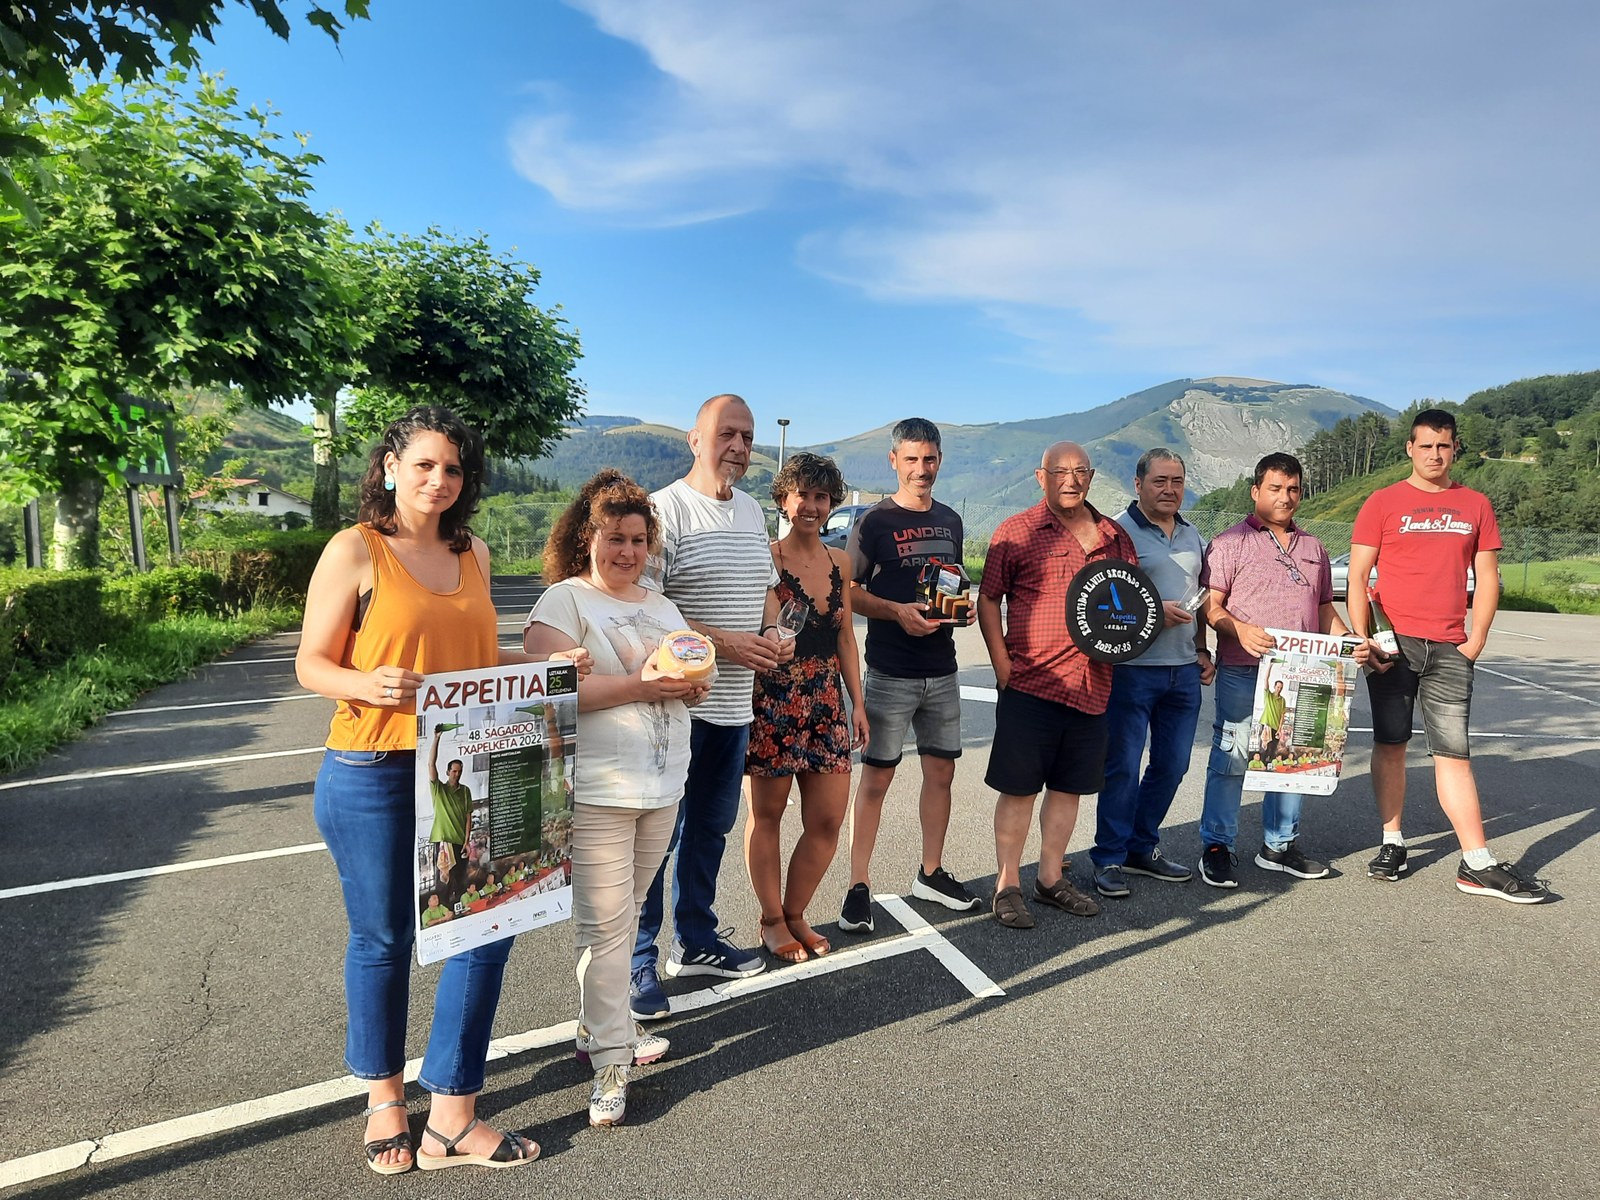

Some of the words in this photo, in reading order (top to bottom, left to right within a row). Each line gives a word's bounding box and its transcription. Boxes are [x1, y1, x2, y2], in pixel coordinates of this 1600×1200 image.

[893, 527, 953, 542] UNDER
[1110, 612, 1137, 621] Azpeitia
[1094, 639, 1132, 654] 2022-07-25
[1281, 673, 1317, 682] TXAPELKETA
[1318, 677, 1333, 685] 2022
[1299, 667, 1329, 677] SAGARDO
[549, 676, 562, 689] 25
[422, 674, 545, 711] AZPEITIA
[469, 730, 483, 740] 48.
[484, 722, 534, 739] SAGARDO
[458, 738, 517, 756] TXAPELKETA
[519, 734, 542, 746] 2022
